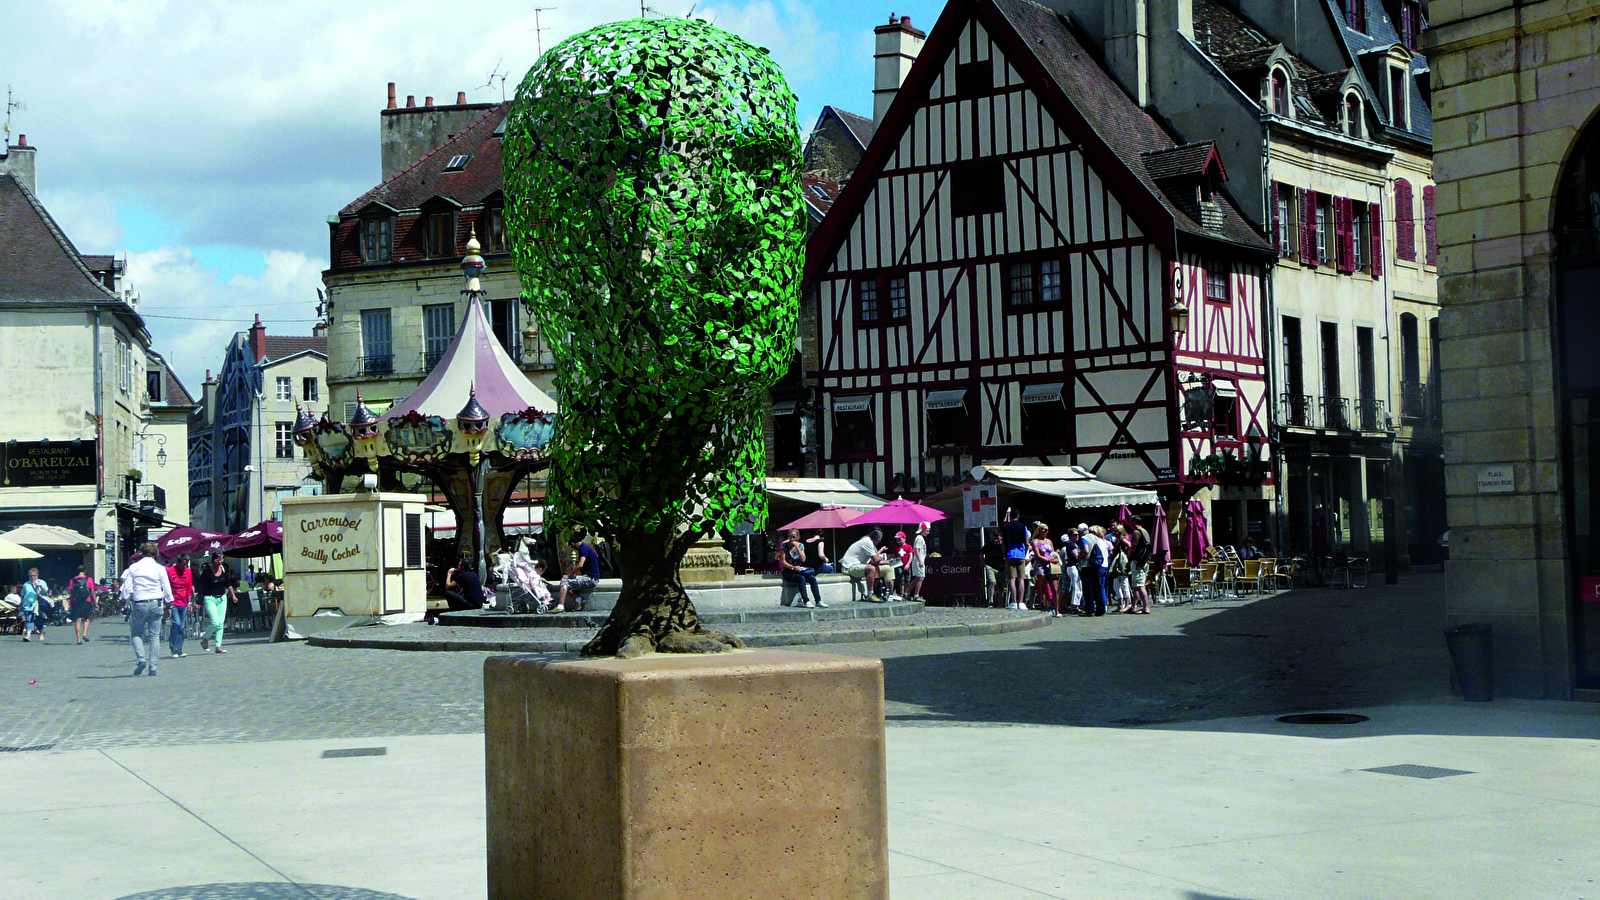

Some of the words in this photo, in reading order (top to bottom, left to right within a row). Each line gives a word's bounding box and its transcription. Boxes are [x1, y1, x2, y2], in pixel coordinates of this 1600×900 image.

[1025, 394, 1058, 402] RESTAURANT
[28, 447, 70, 455] RESTAURANT
[9, 456, 90, 468] O'BAREUZAI
[300, 516, 362, 533] Carrousel
[319, 533, 344, 543] 1900
[301, 546, 329, 565] Bailly
[331, 543, 361, 561] Cochet
[941, 565, 971, 574] Glacier
